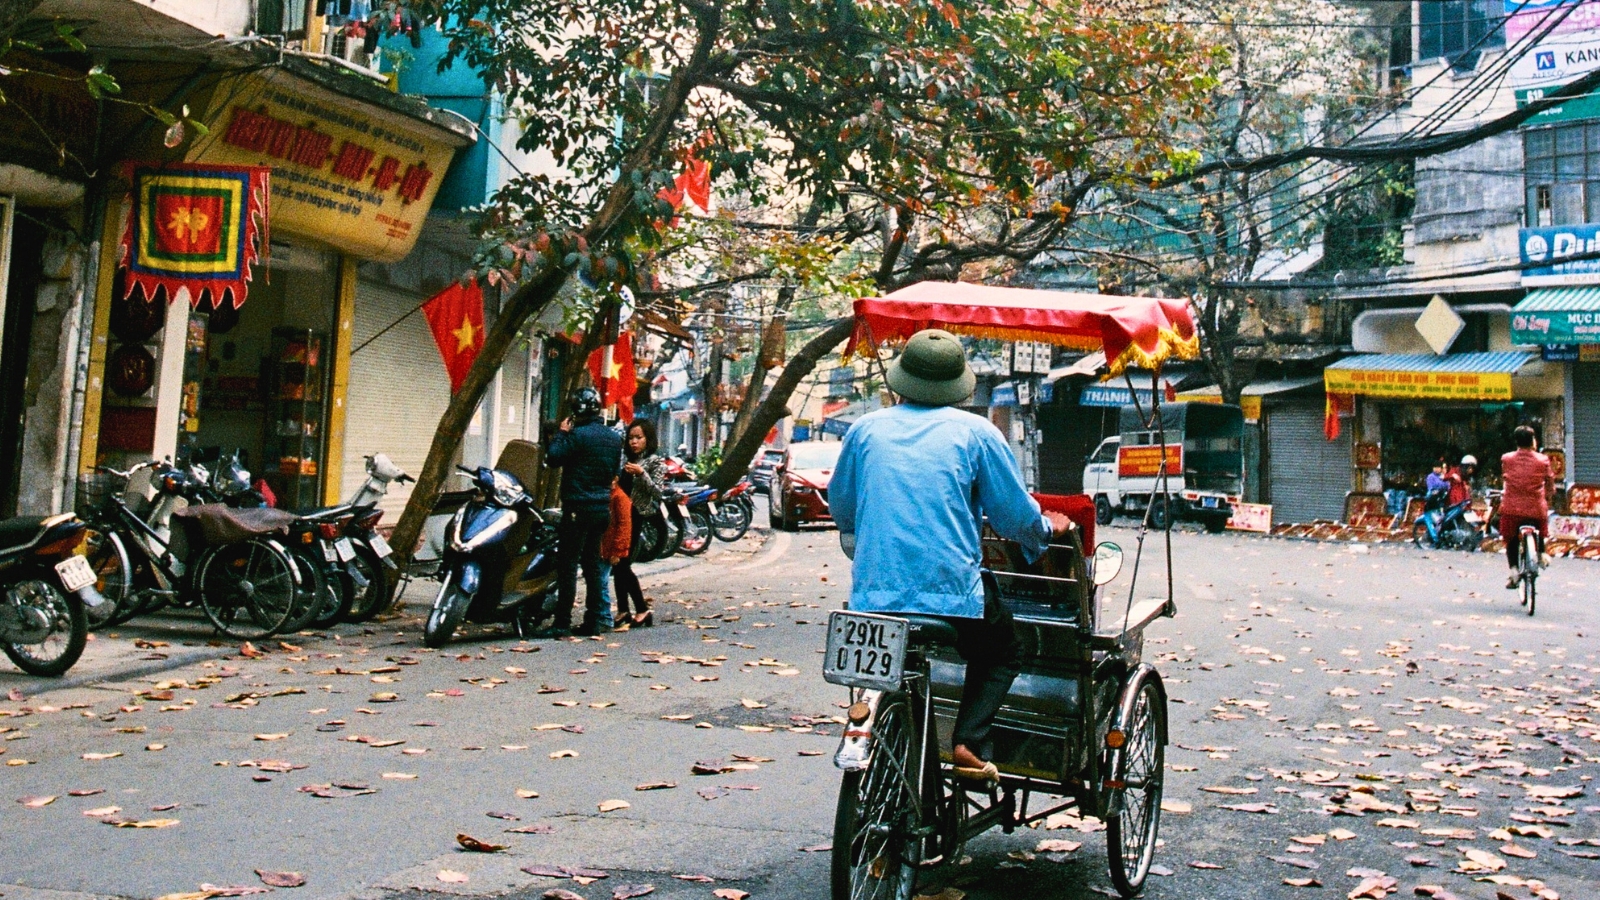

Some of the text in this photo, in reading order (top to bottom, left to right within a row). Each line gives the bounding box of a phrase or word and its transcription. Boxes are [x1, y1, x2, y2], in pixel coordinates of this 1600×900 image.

[1565, 48, 1600, 65] KAN
[1567, 313, 1592, 325] MỤC
[1085, 390, 1131, 403] THANH
